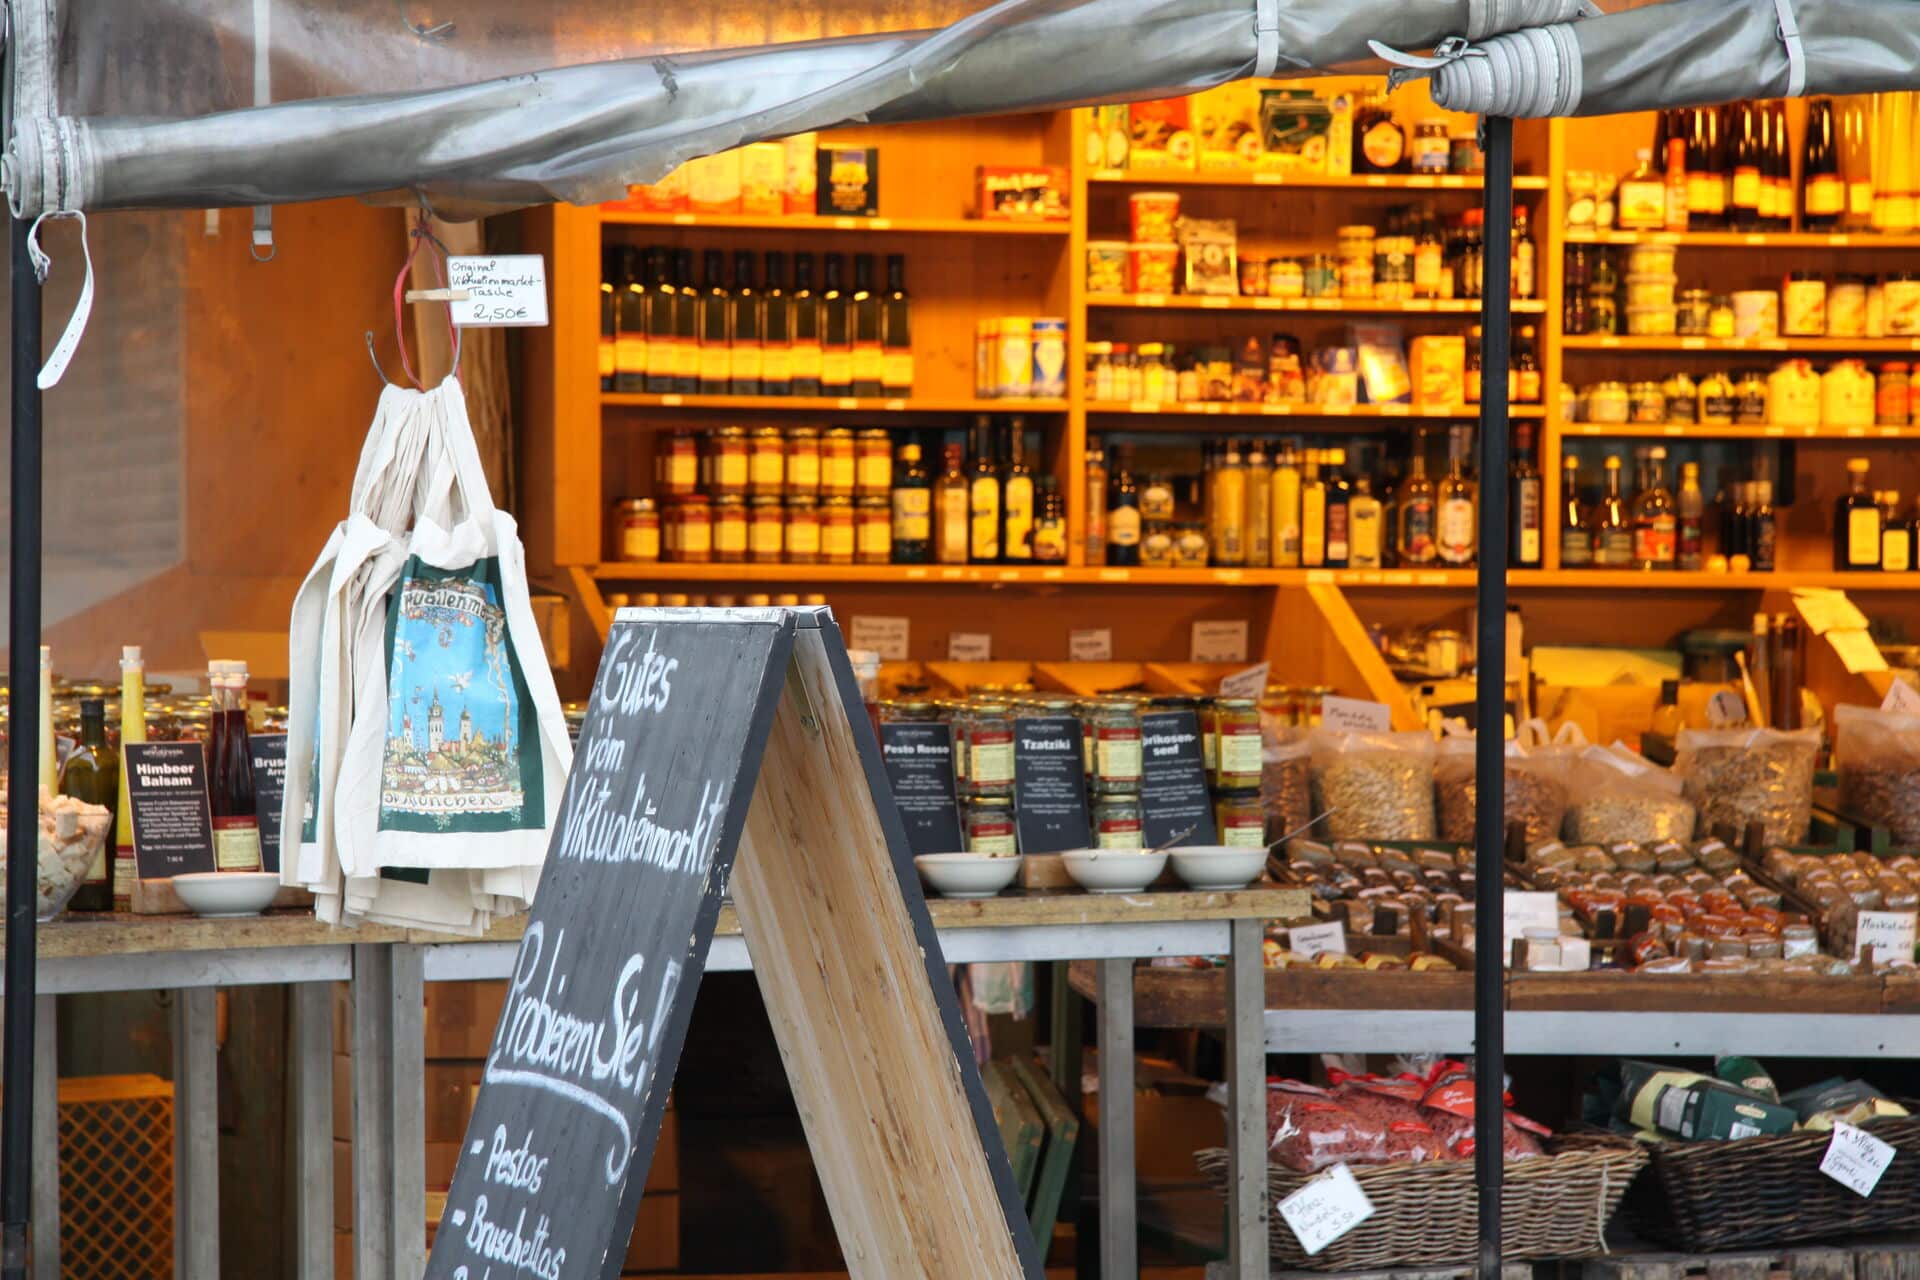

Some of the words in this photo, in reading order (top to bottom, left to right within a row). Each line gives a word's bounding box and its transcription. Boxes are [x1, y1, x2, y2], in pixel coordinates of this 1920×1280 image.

[451, 260, 496, 277] Original
[467, 285, 513, 298] Tasche
[473, 303, 529, 323] 2,50€
[883, 744, 915, 754] Pesto
[916, 744, 950, 754] Rosso
[1021, 738, 1071, 751] Tzatziki
[1153, 744, 1180, 757] senf
[136, 763, 195, 776] Himbeer
[141, 775, 193, 788] Balsam
[496, 920, 595, 1078] Probieren
[483, 1123, 549, 1195] Pestos
